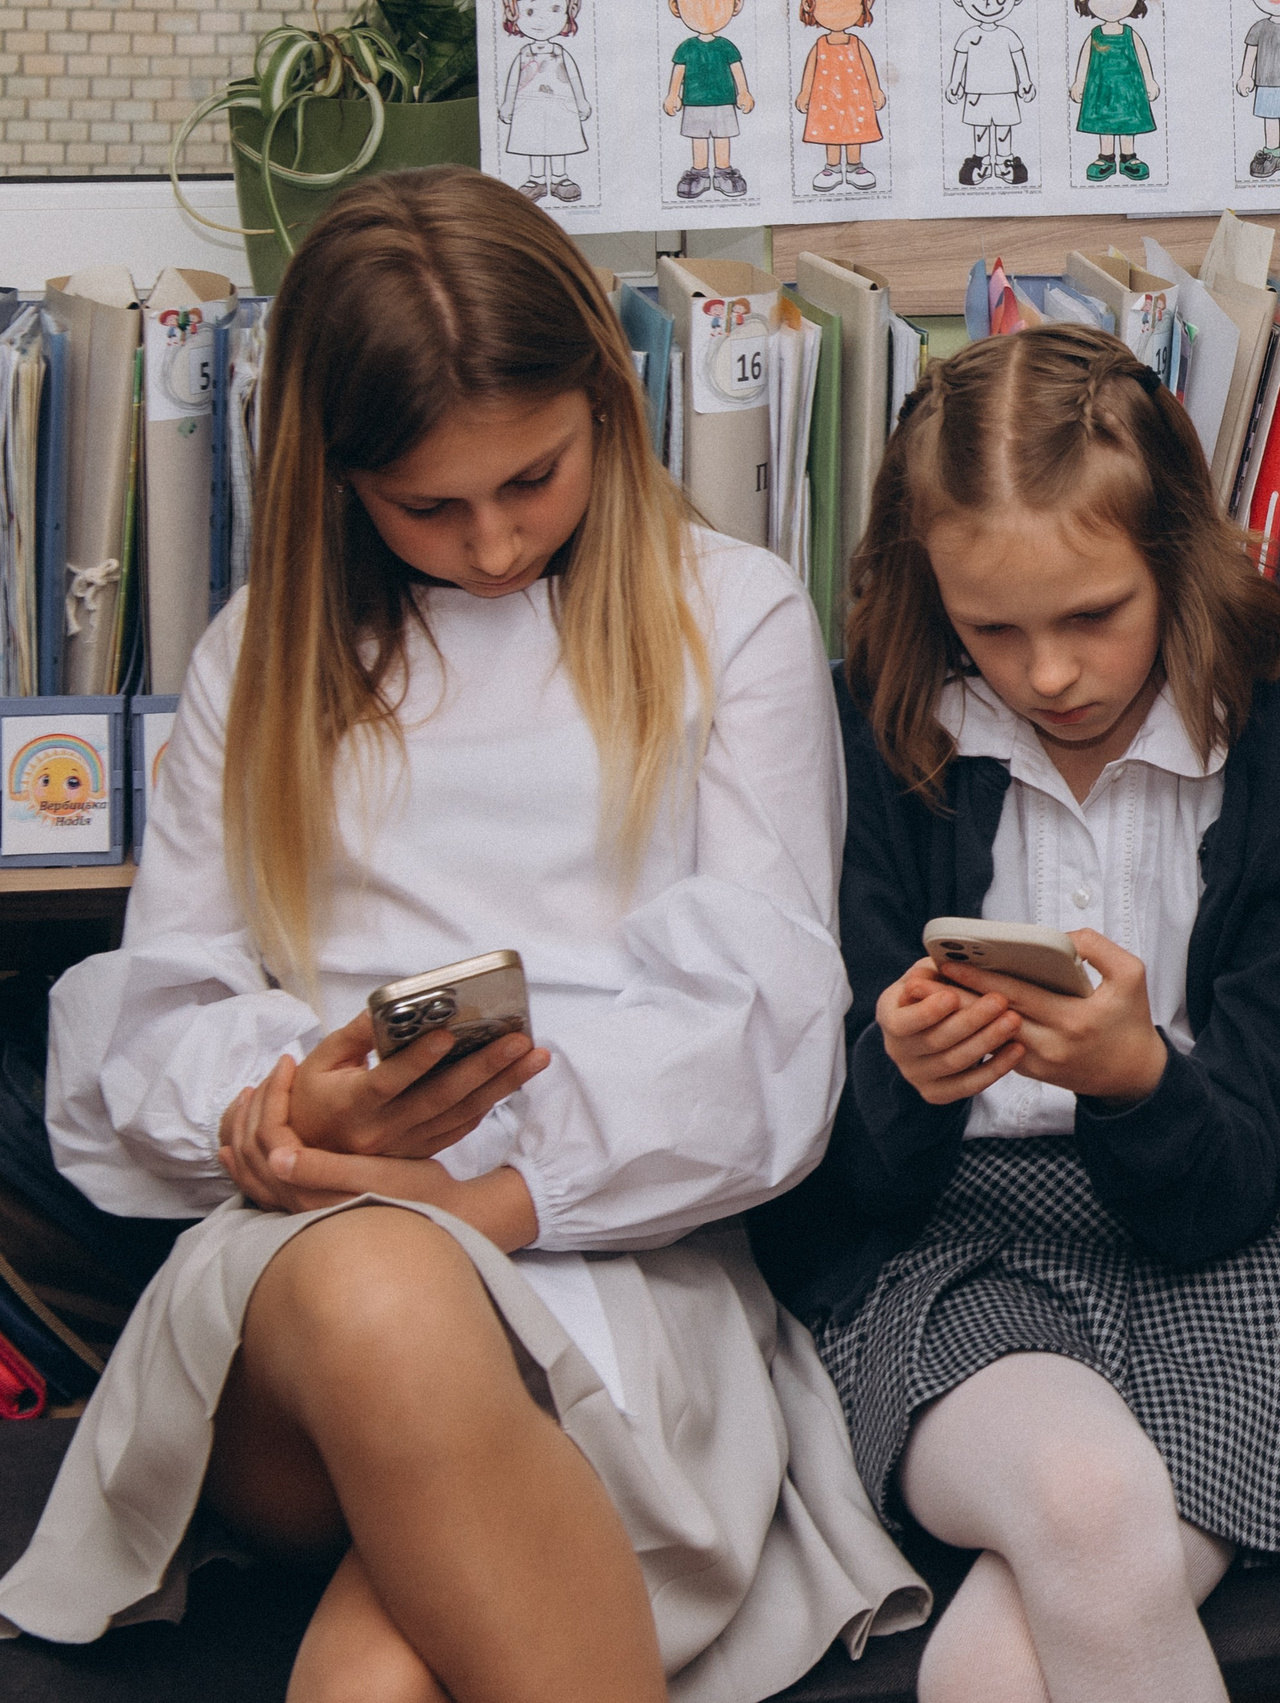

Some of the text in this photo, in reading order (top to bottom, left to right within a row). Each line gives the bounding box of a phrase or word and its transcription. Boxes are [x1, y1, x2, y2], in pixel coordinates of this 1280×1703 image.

[737, 351, 761, 382] 16
[1156, 346, 1167, 375] 19
[200, 361, 210, 391] 5
[39, 800, 107, 813] Вербицька
[55, 815, 92, 827] Надія
